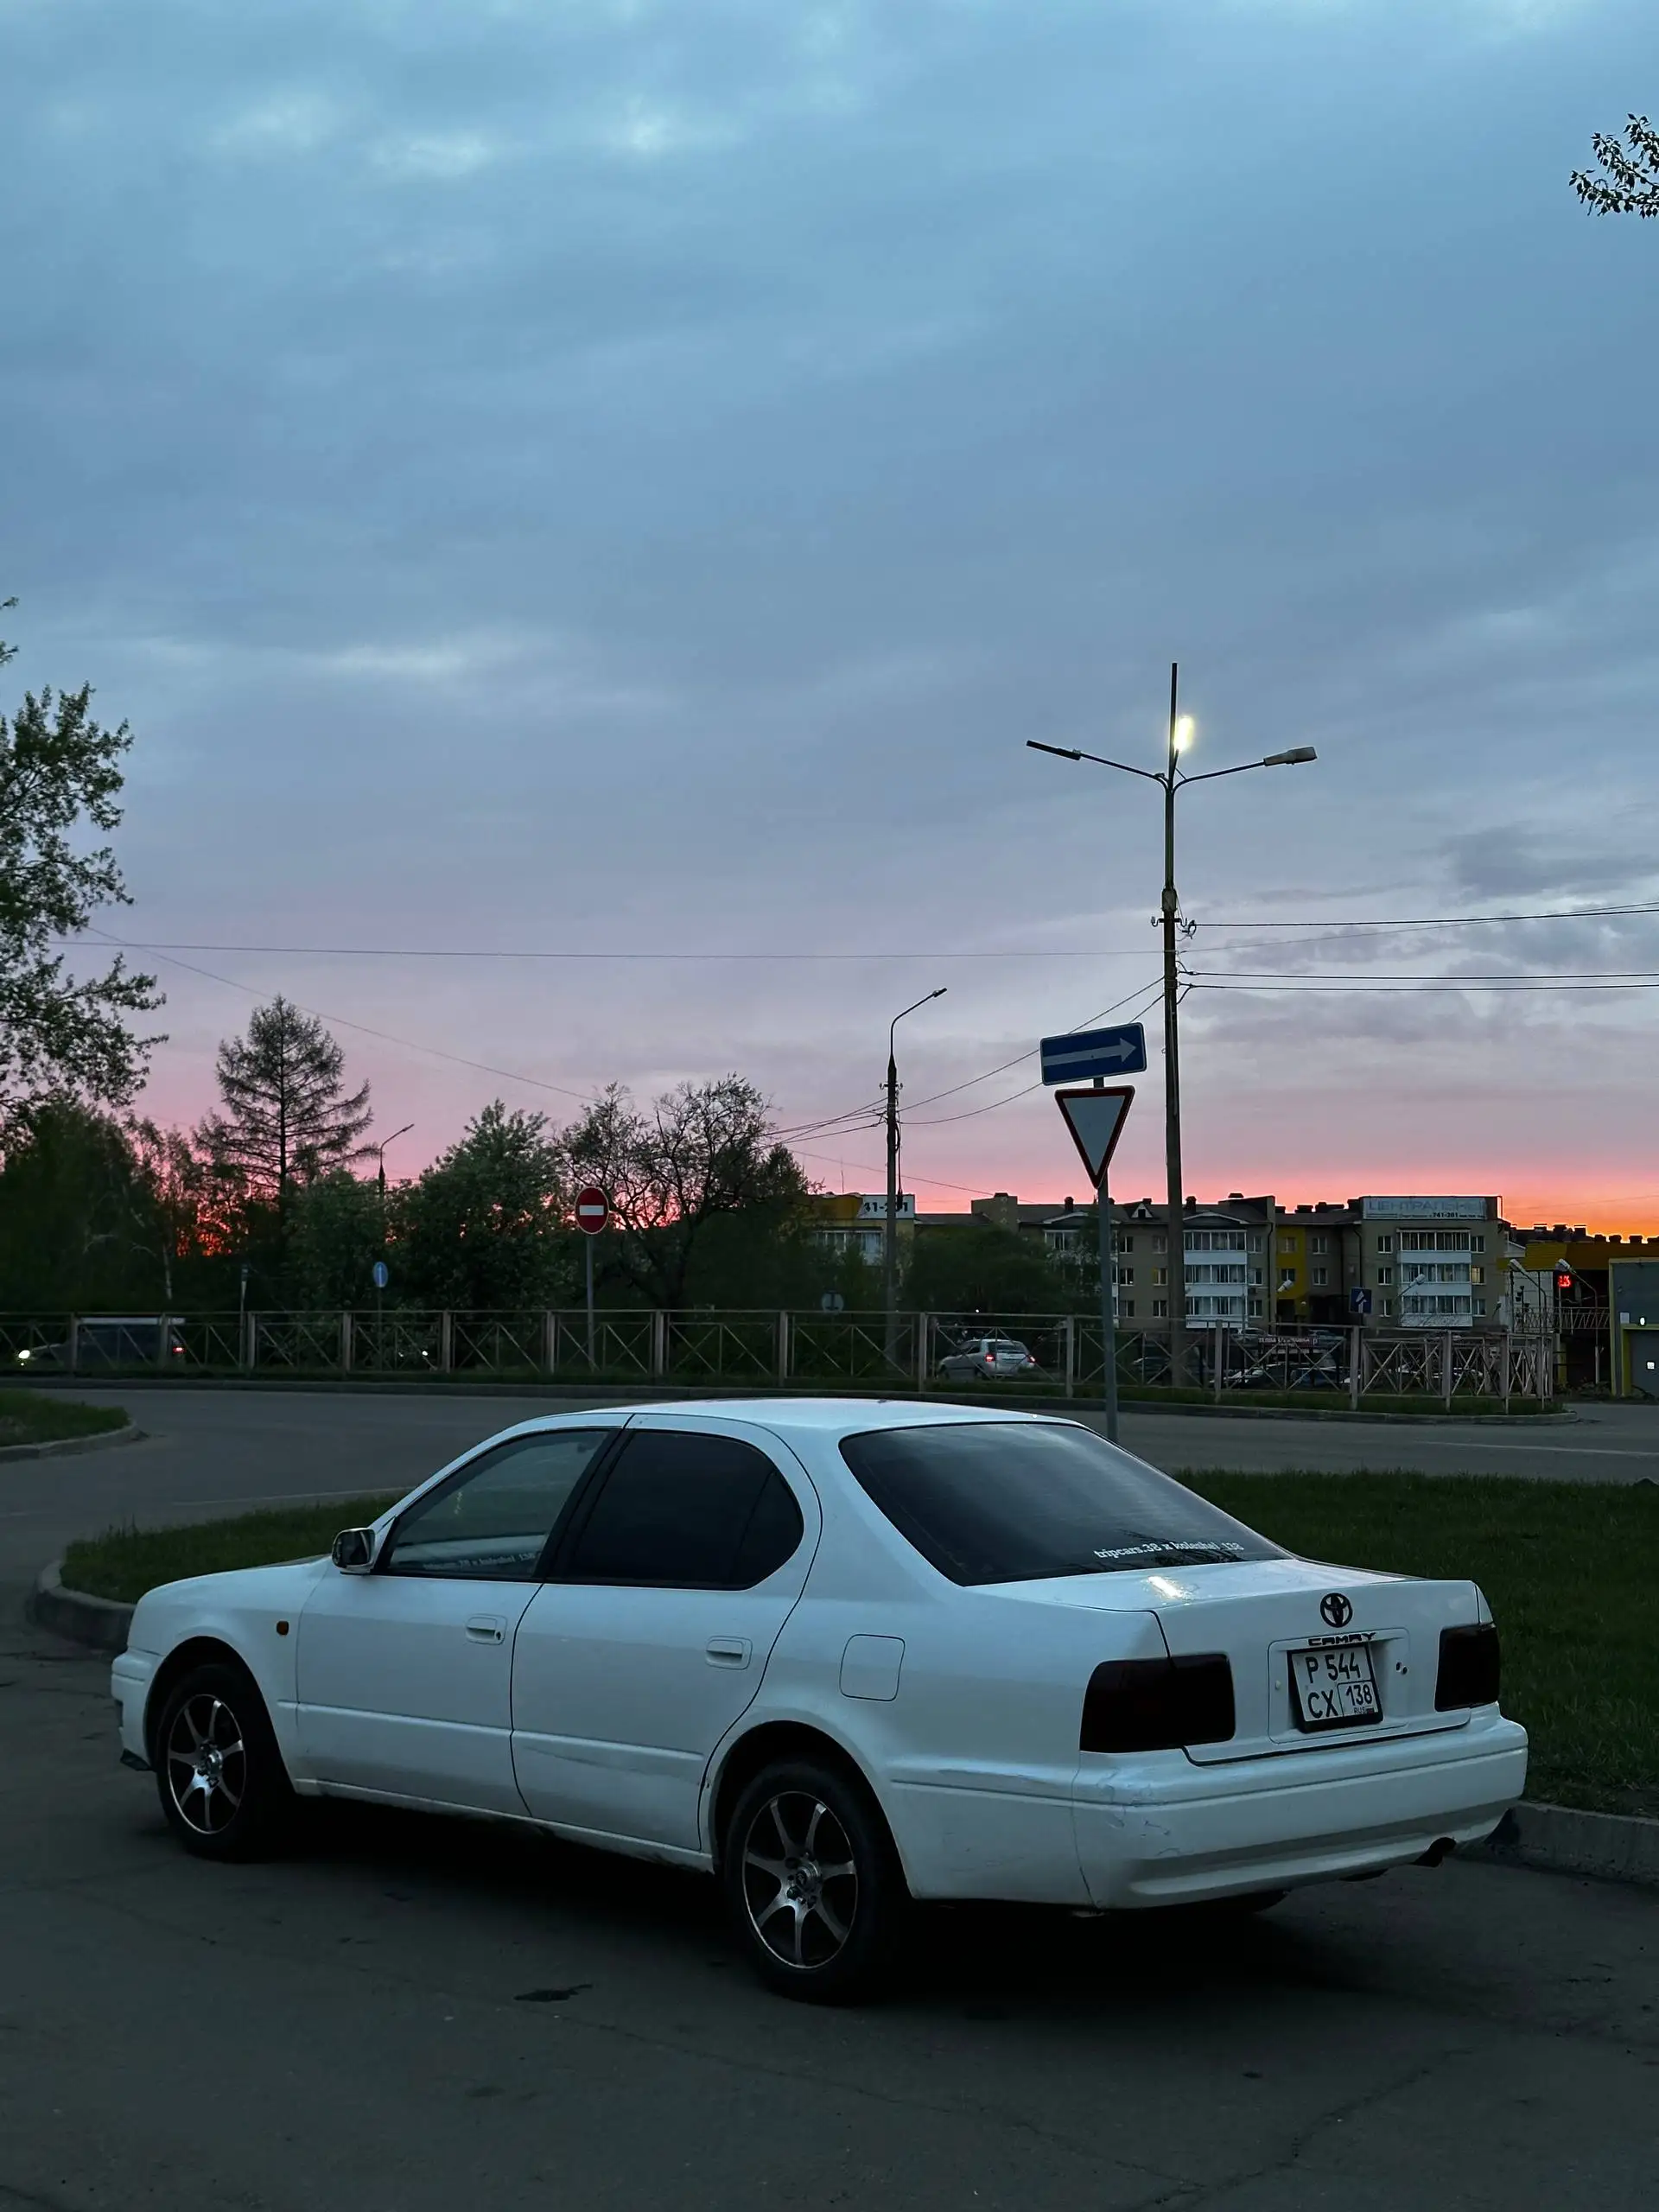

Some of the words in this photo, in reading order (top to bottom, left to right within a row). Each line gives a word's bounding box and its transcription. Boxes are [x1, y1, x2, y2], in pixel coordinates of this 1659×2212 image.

[1308, 1632, 1376, 1646] CAMRY
[1325, 1652, 1361, 1681] 544
[1346, 1684, 1372, 1706] 138
